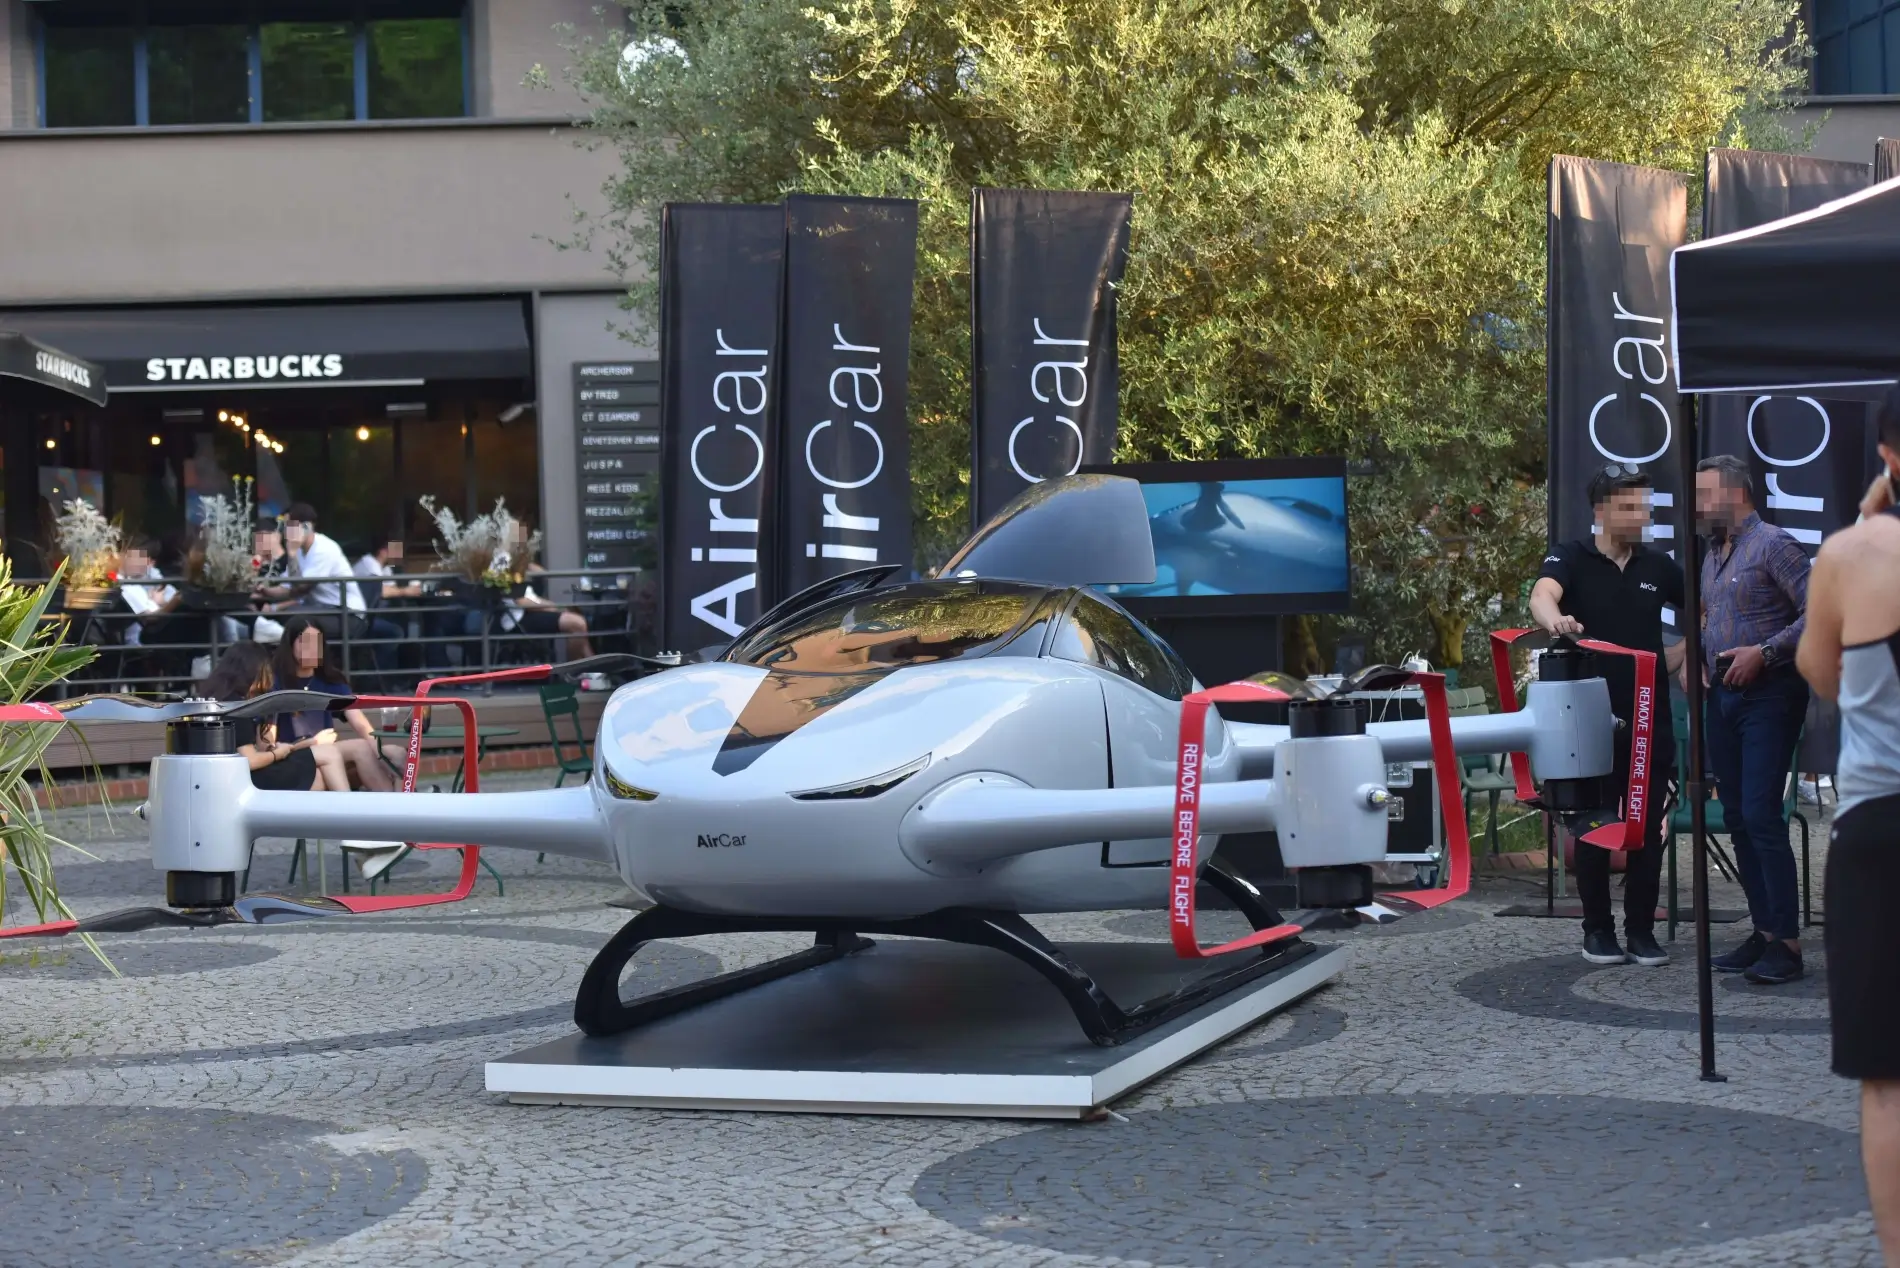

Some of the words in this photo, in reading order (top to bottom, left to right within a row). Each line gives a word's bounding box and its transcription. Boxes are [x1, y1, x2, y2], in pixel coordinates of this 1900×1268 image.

[35, 350, 92, 390] STARBUCKS
[146, 353, 343, 381] STARBUCKS
[1008, 317, 1090, 484] Car
[806, 323, 883, 562] irCar
[584, 460, 623, 470] JUSPA
[691, 328, 768, 638] AirCar
[614, 482, 640, 493] KIDS
[1640, 582, 1658, 592] AirCar
[1637, 686, 1651, 732] REMOVE
[409, 719, 420, 759] REMOVE
[1633, 737, 1648, 779] BEFORE
[403, 763, 415, 793] BEFOR
[1180, 743, 1199, 804] REMOVE
[1629, 785, 1643, 822] FLIGHT
[697, 833, 747, 848] AirCar
[1176, 811, 1194, 868] BEFORE
[1174, 876, 1190, 927] FLIGHT
